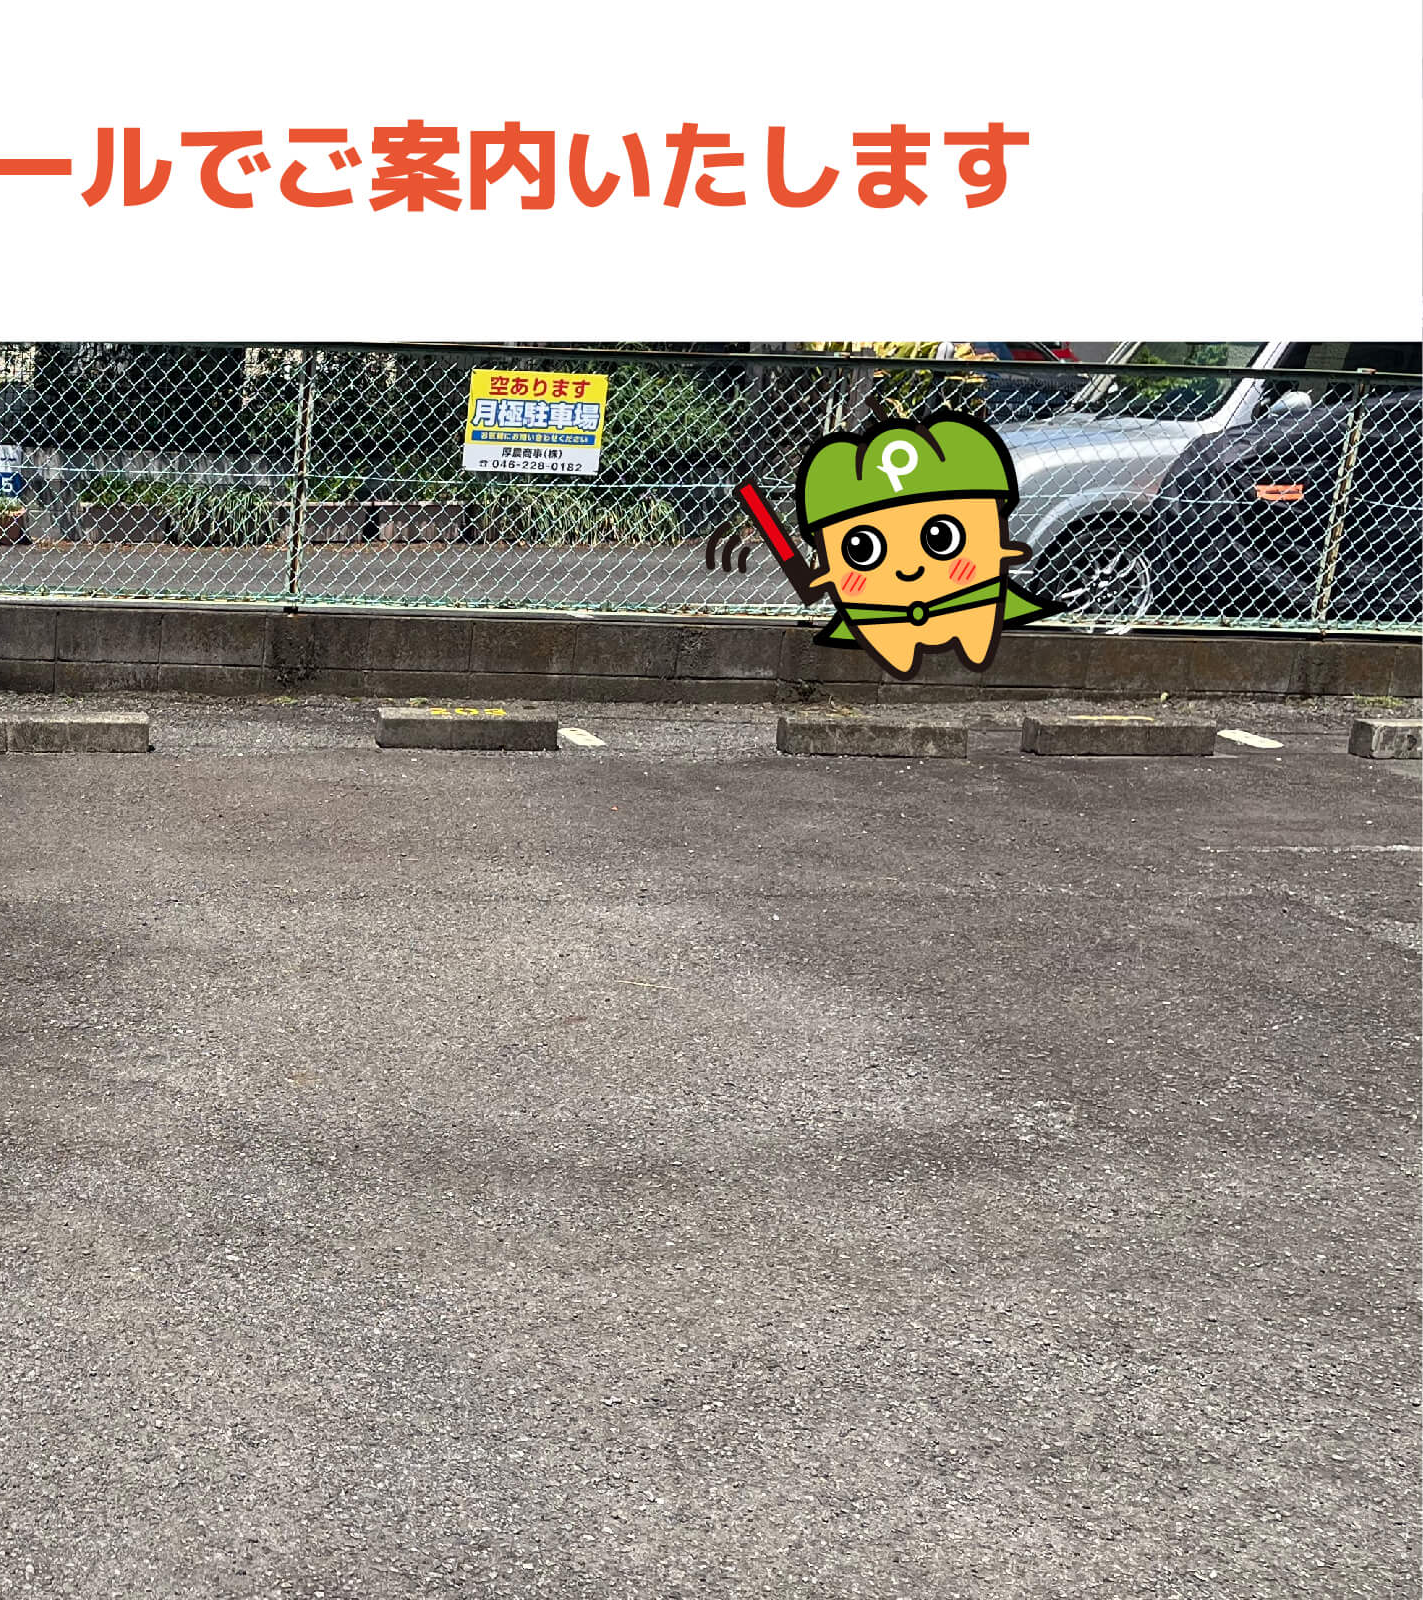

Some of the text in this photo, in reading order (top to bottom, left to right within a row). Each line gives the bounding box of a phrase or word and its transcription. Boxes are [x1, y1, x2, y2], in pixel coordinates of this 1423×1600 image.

[489, 376, 590, 398] 空あります
[471, 399, 601, 432] 月極駐車場
